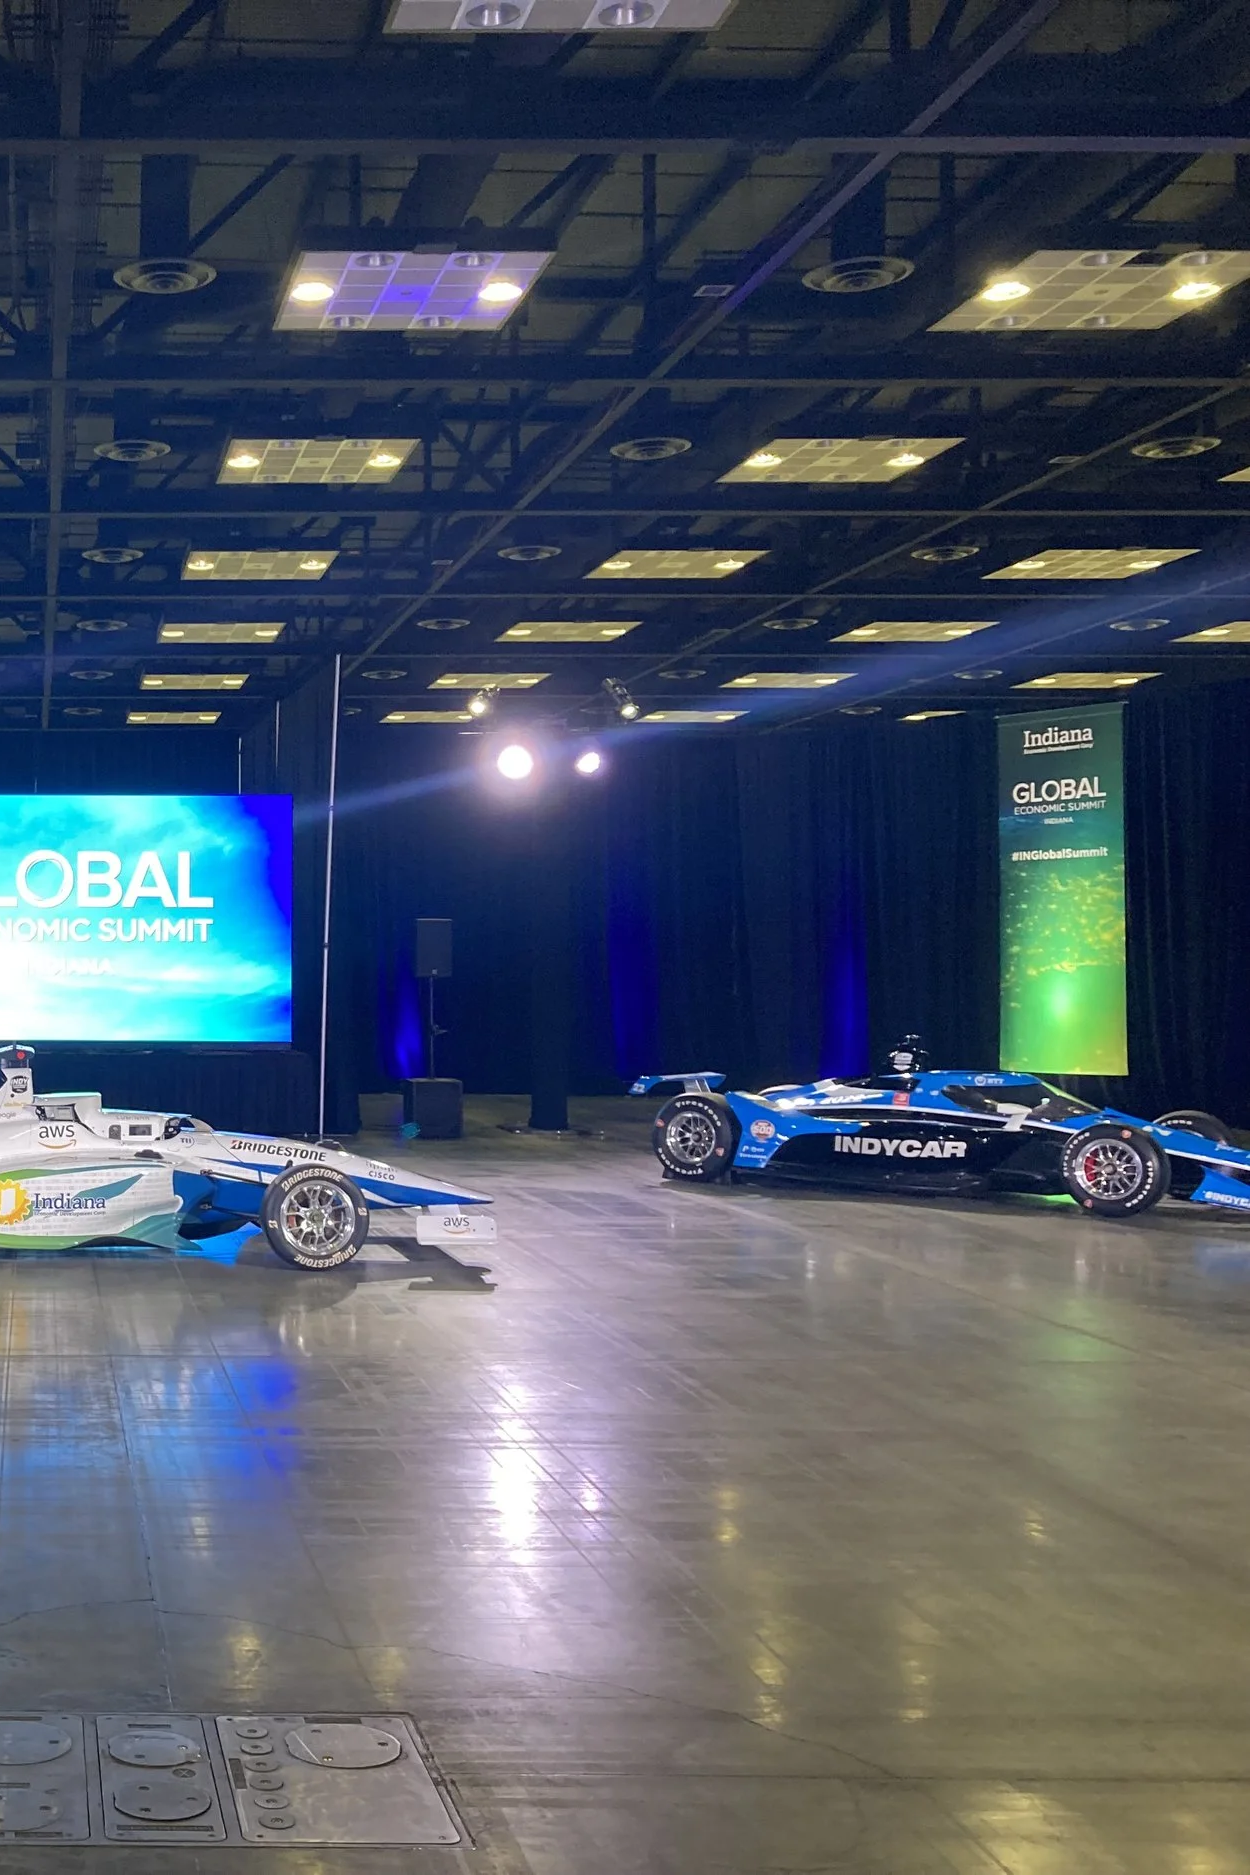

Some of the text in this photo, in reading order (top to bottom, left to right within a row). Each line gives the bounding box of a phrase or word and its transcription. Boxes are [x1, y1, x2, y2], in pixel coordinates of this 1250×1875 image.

[1023, 726, 1094, 748] Indiana
[1013, 776, 1107, 804] GLOBAL
[1014, 800, 1107, 815] ECONOMIC SUMMIT
[1012, 846, 1109, 861] #INGlobalSummit
[97, 917, 214, 943] SUMMIT
[39, 1125, 75, 1138] aws
[231, 1139, 327, 1162] BRIDGESTONE
[834, 1135, 968, 1158] INDYCAR
[281, 1168, 344, 1193] BRIDGESTONE
[34, 1193, 106, 1209] Indiana
[443, 1217, 470, 1227] aws
[293, 1244, 357, 1268] BRIDGESTONE
